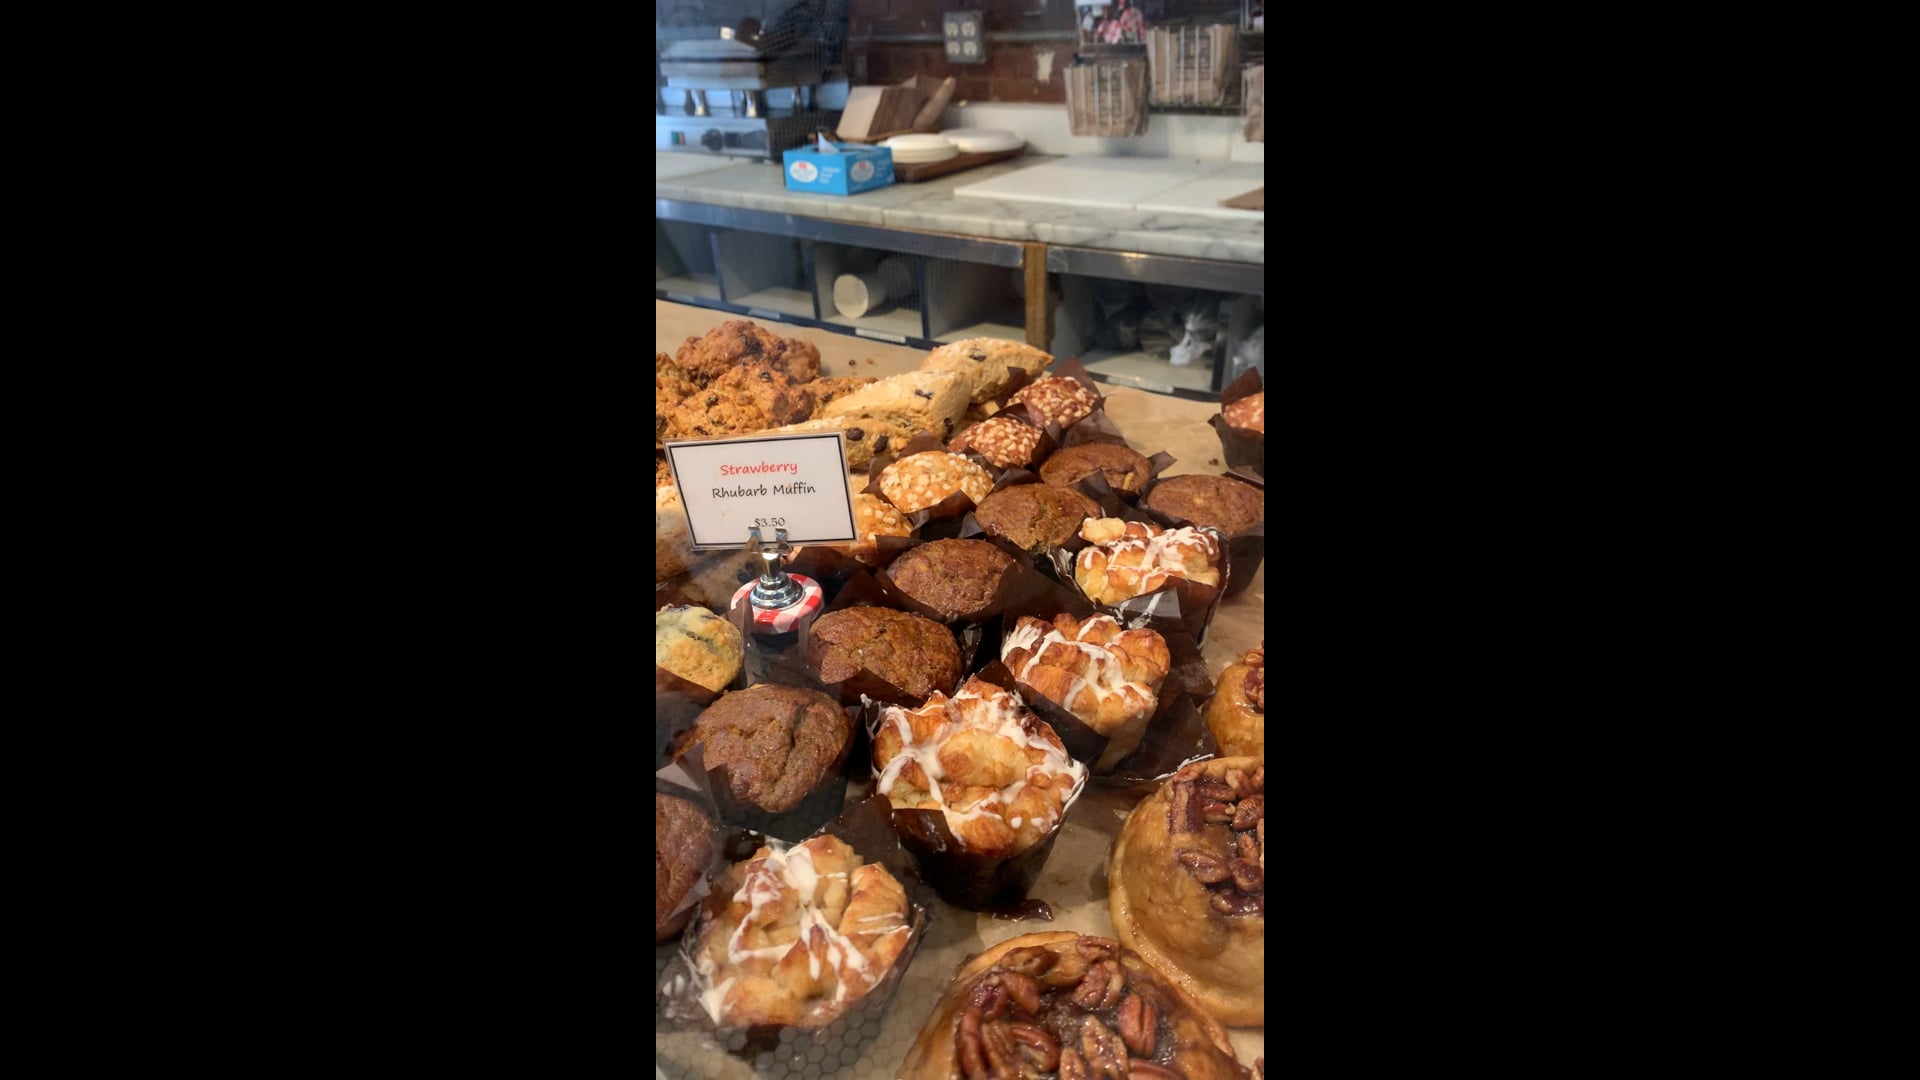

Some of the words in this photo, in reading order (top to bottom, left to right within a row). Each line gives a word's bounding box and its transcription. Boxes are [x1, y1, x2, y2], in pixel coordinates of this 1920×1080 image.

[720, 461, 798, 476] Strawberry
[712, 484, 767, 498] Rhubarb
[773, 482, 816, 496] Muffin
[754, 517, 785, 528] $3.50
